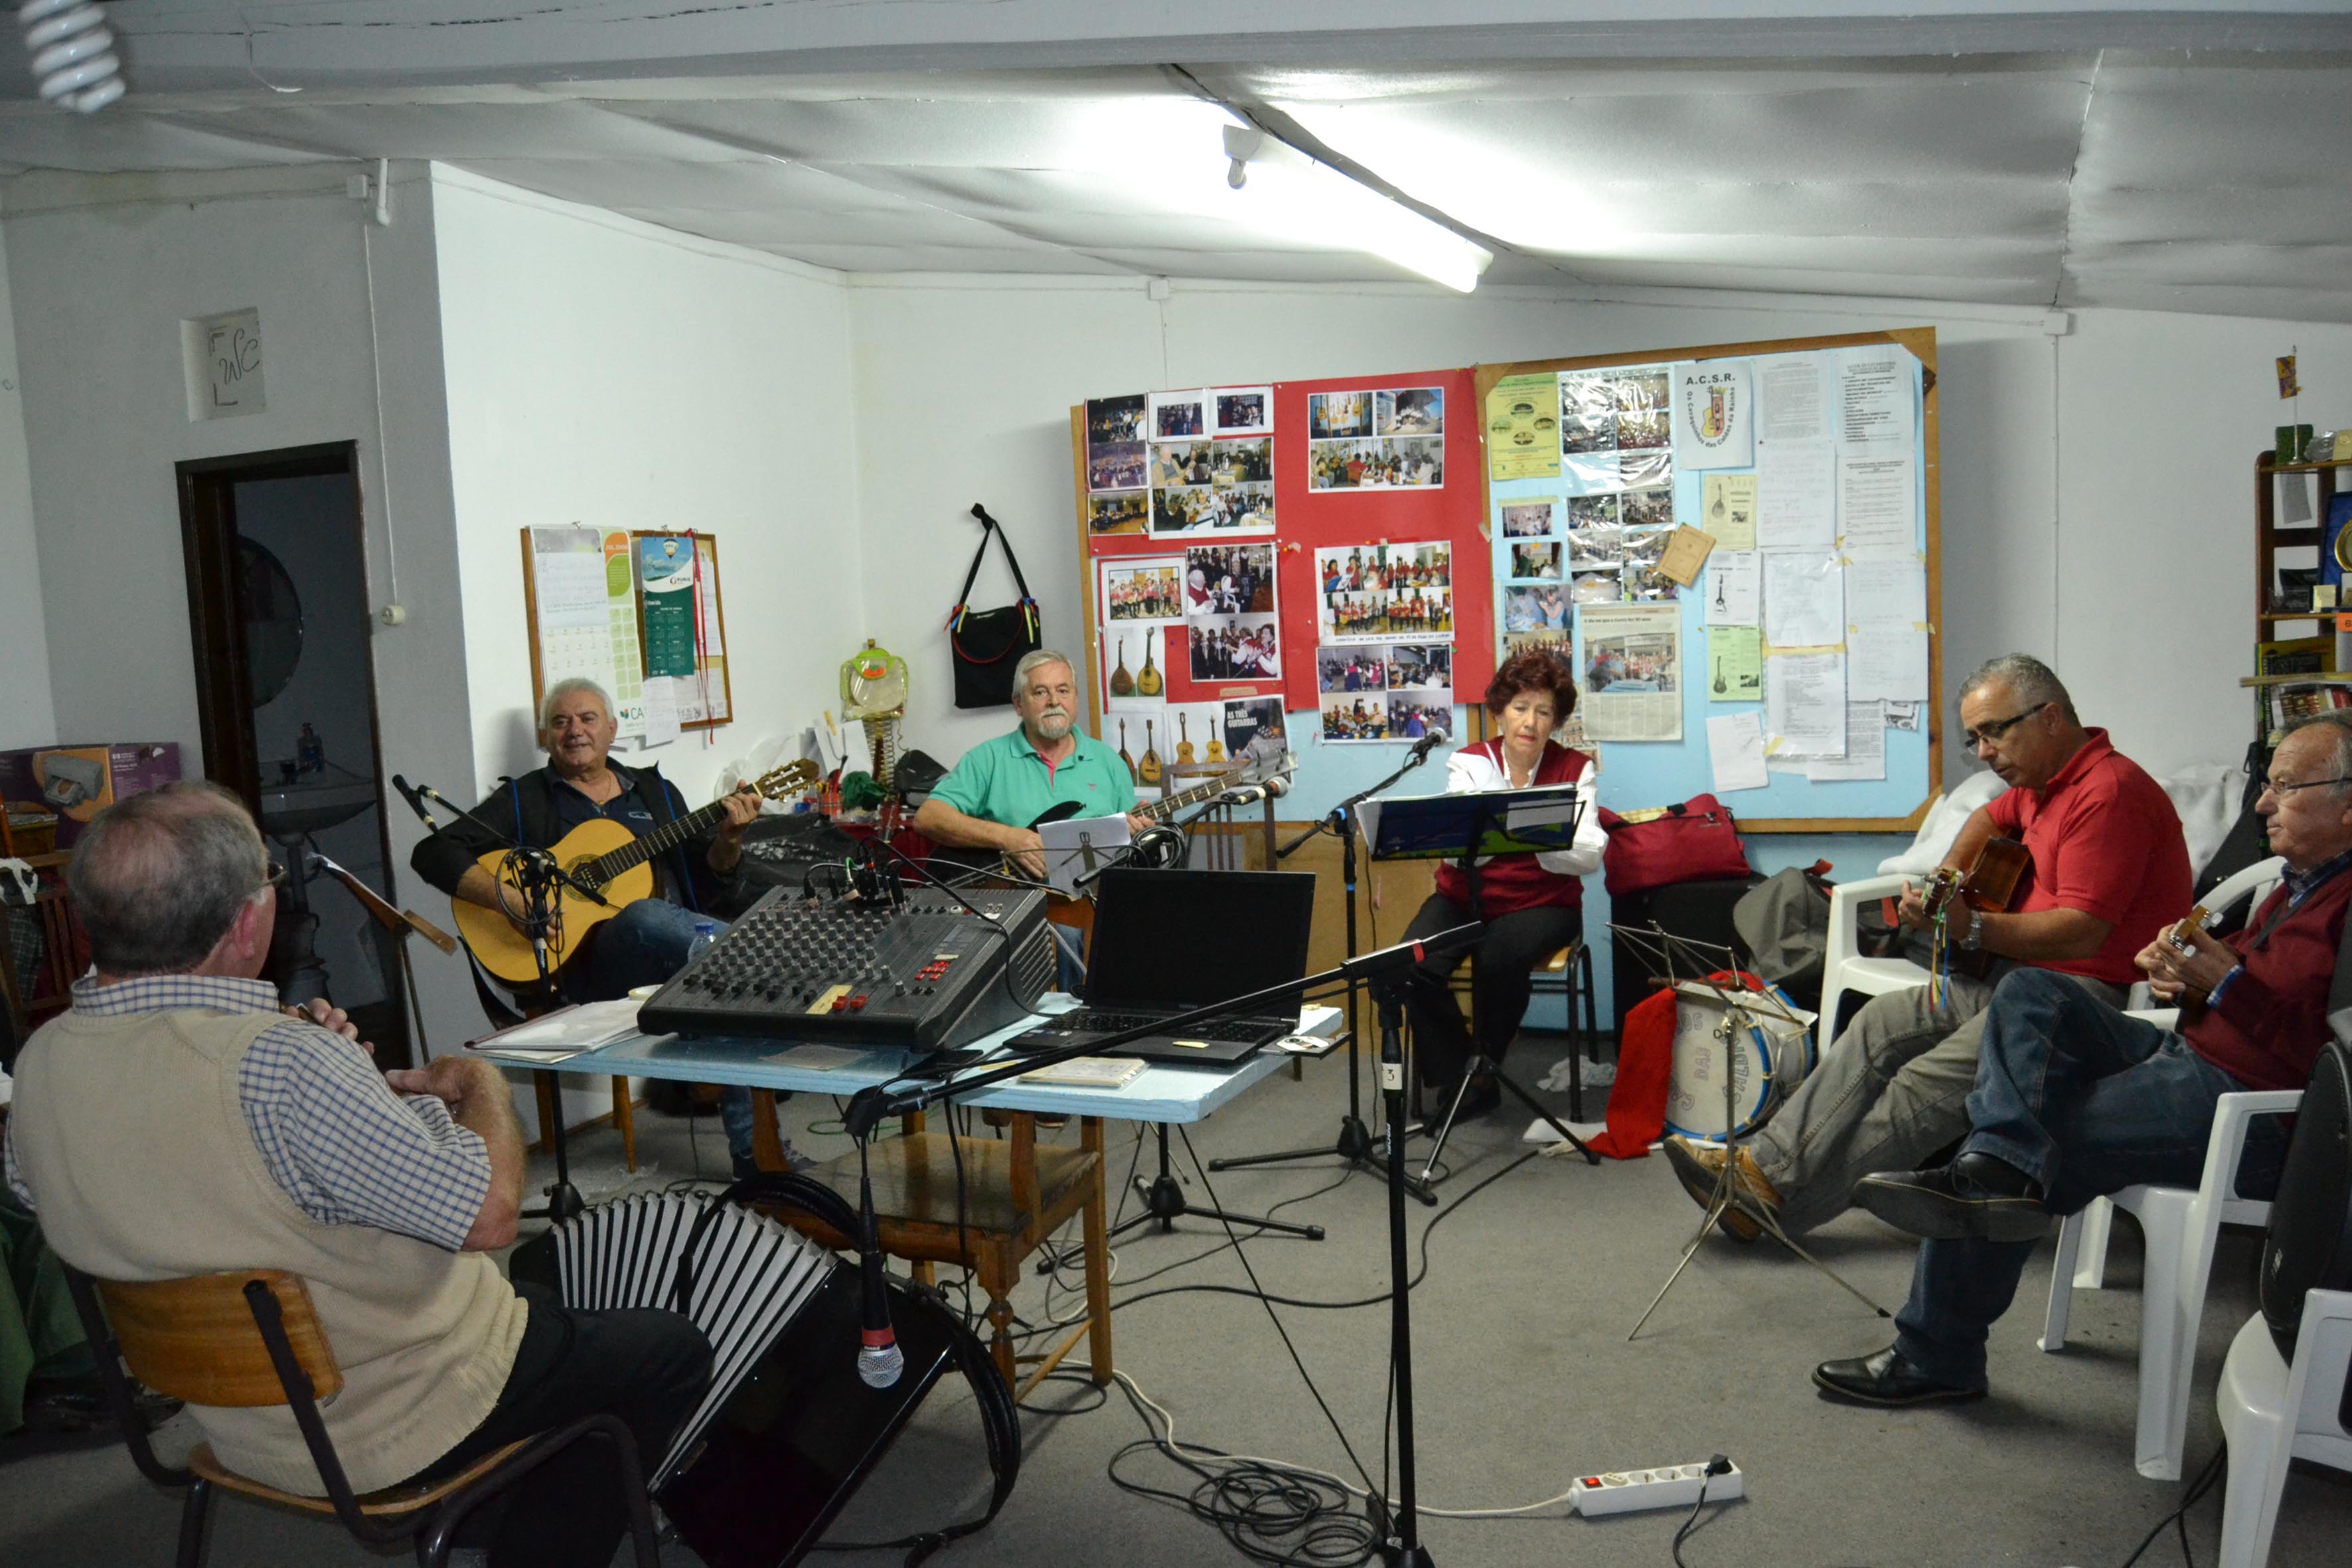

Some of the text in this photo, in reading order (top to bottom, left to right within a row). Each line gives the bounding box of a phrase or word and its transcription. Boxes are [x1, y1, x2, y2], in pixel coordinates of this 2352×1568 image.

[219, 328, 260, 385] WC
[1686, 373, 1735, 385] A.C.S.R.
[1728, 414, 1734, 423] da
[631, 707, 644, 720] CA
[1227, 708, 1248, 720] AS TRÊS
[1227, 717, 1258, 728] GUITARRAS
